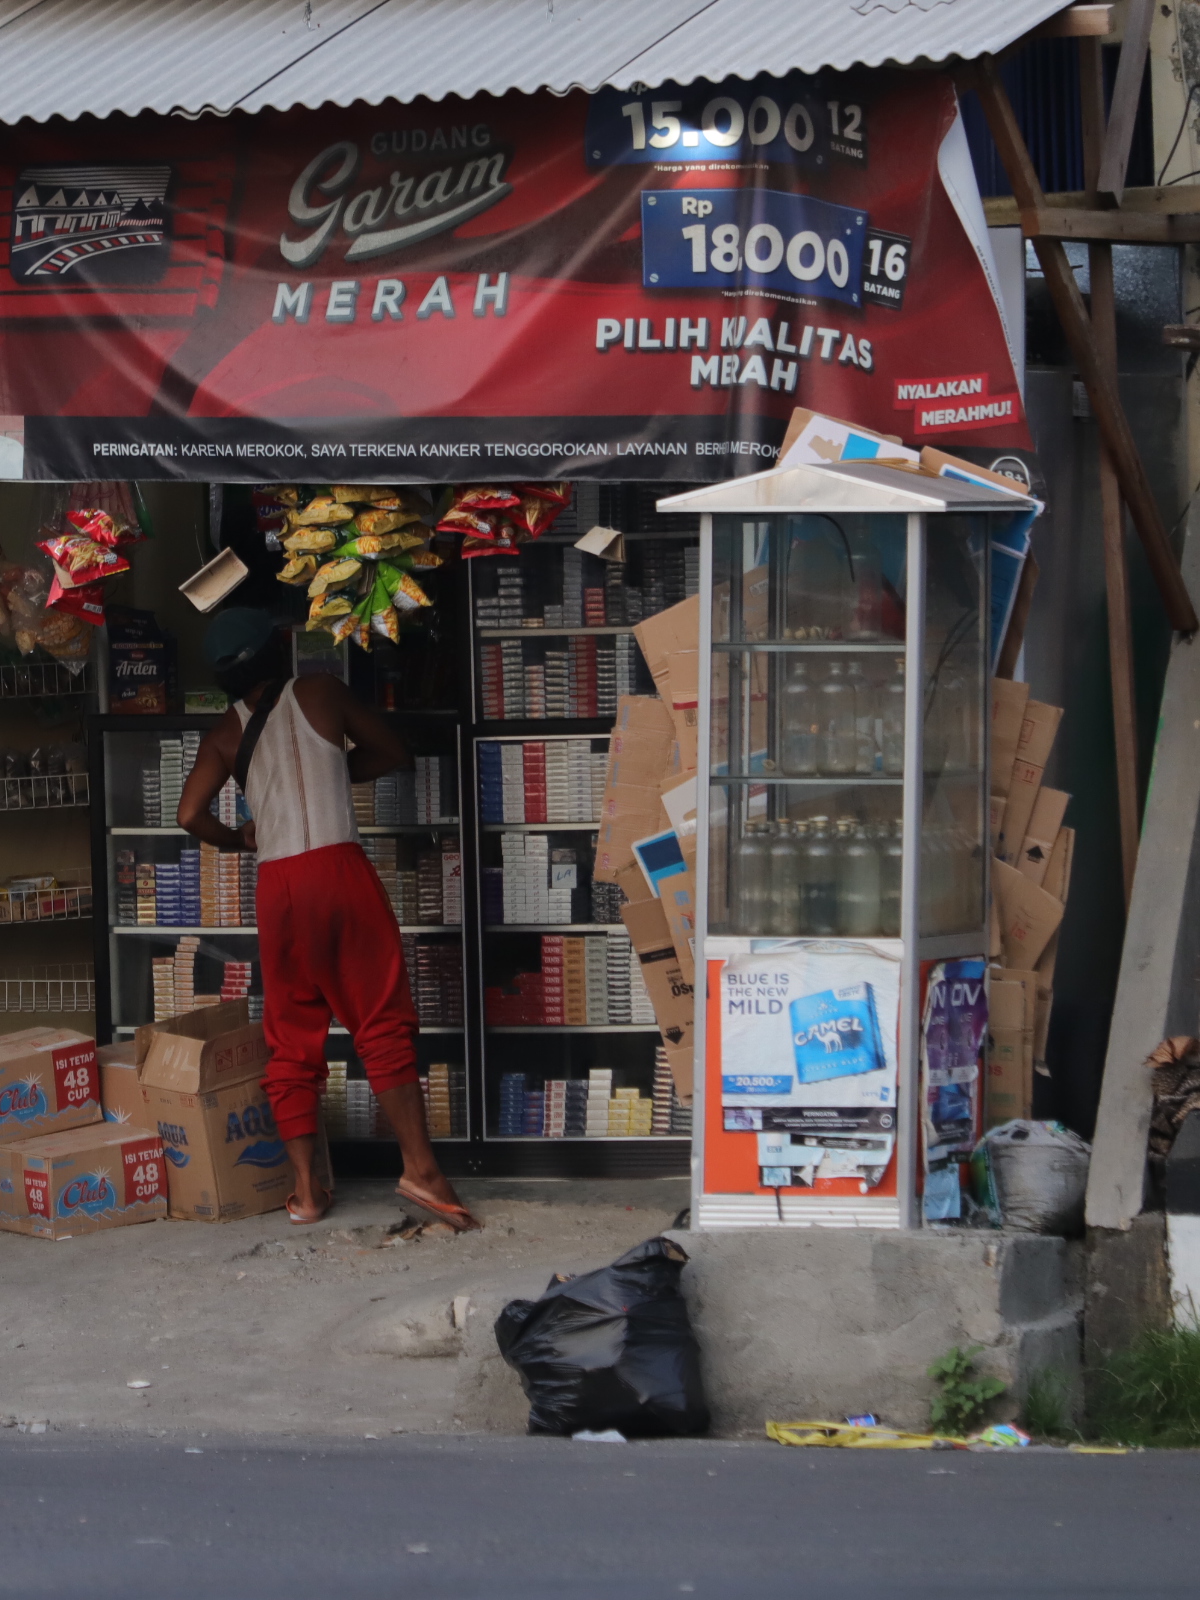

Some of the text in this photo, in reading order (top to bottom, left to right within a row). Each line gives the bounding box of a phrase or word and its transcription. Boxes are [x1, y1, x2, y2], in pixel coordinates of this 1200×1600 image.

[621, 95, 862, 152] 15.000 12
[370, 123, 491, 155] GUDANG
[830, 141, 864, 160] BATANG
[279, 140, 512, 268] Garam
[682, 197, 713, 218] Rp
[869, 239, 906, 282] 16
[271, 271, 510, 324] MERAH
[864, 281, 900, 299] BATANG
[595, 317, 708, 350] PILIH
[898, 379, 982, 400] NYALAKAN
[921, 400, 1012, 426] MERAHMU!
[93, 443, 177, 457] PERINGATAN:
[181, 444, 233, 457] KARENA
[236, 444, 307, 459] MEROKOK,
[311, 443, 346, 457] SAYA
[349, 443, 417, 457] TERKENA
[419, 443, 481, 457] KANKER
[484, 442, 612, 457] TENGGOROKAN.
[616, 442, 687, 456] LAYANAN
[116, 660, 158, 677] Arden
[727, 973, 790, 985] BLUE IS
[727, 987, 789, 997] THE NEW
[728, 999, 783, 1015] MILD
[794, 1016, 864, 1046] CAMEL
[56, 1052, 95, 1070] ISI TETAP
[63, 1067, 89, 1089] 48
[67, 1087, 90, 1102] CUP
[157, 1120, 188, 1148] AQUA
[125, 1148, 164, 1165] ISI TETAP
[133, 1163, 159, 1184] 48
[29, 1188, 43, 1203] 48
[64, 1177, 108, 1209] Club
[136, 1183, 159, 1197] CUP
[33, 1202, 45, 1210] CUP
